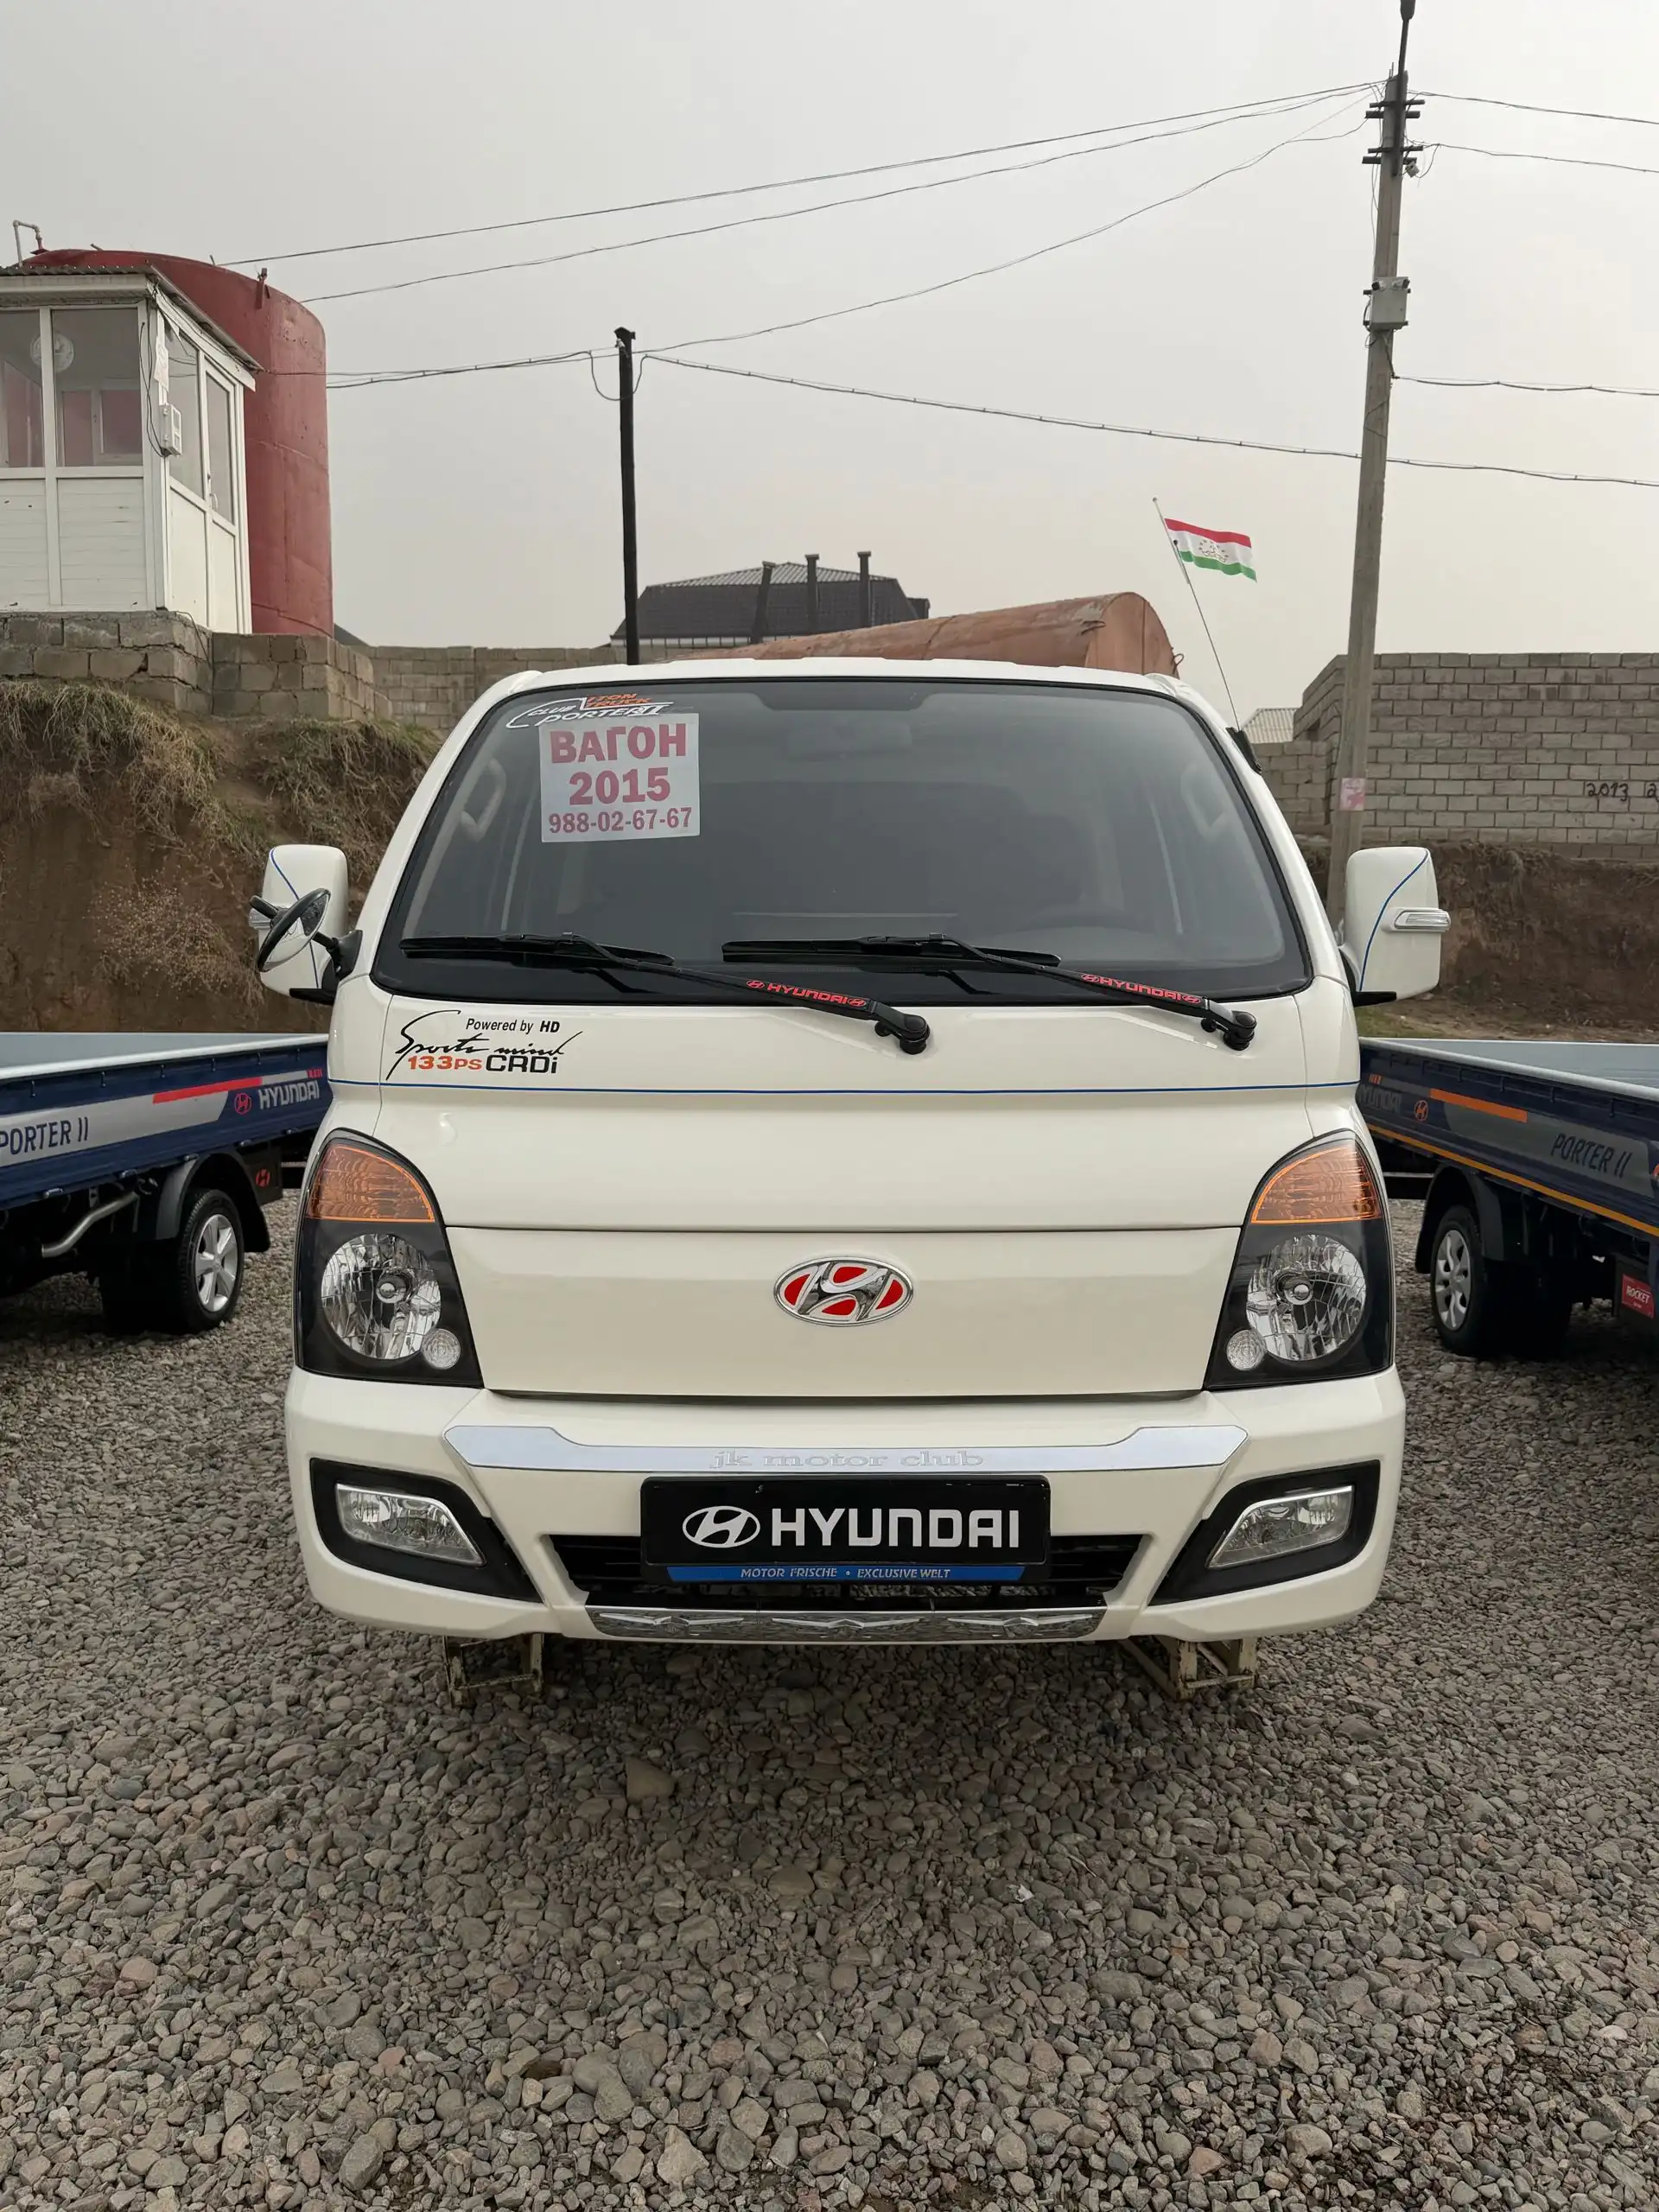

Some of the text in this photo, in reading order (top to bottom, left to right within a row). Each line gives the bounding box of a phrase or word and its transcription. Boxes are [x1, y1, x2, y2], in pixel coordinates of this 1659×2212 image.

[536, 706, 643, 726] PORTER
[550, 723, 687, 763] ВАГОН
[569, 766, 671, 805] 2015
[1586, 782, 1629, 802] 2013
[548, 806, 692, 834] 988-02-67-67
[767, 982, 848, 1004] HYUNDAI
[1099, 976, 1181, 1001] HYUNDAI
[466, 1018, 561, 1034] Powered by HD
[257, 1079, 321, 1110] HYUNDAI
[0, 1119, 73, 1156] PORTER
[1550, 1133, 1616, 1173] PORTER
[1626, 1285, 1650, 1304] ROCKET
[709, 1451, 984, 1470] jk motor club
[771, 1508, 1020, 1548] HYUNDAI
[741, 1567, 951, 1579] MOTOR FRISCHE EXCLUSIVE WELT
